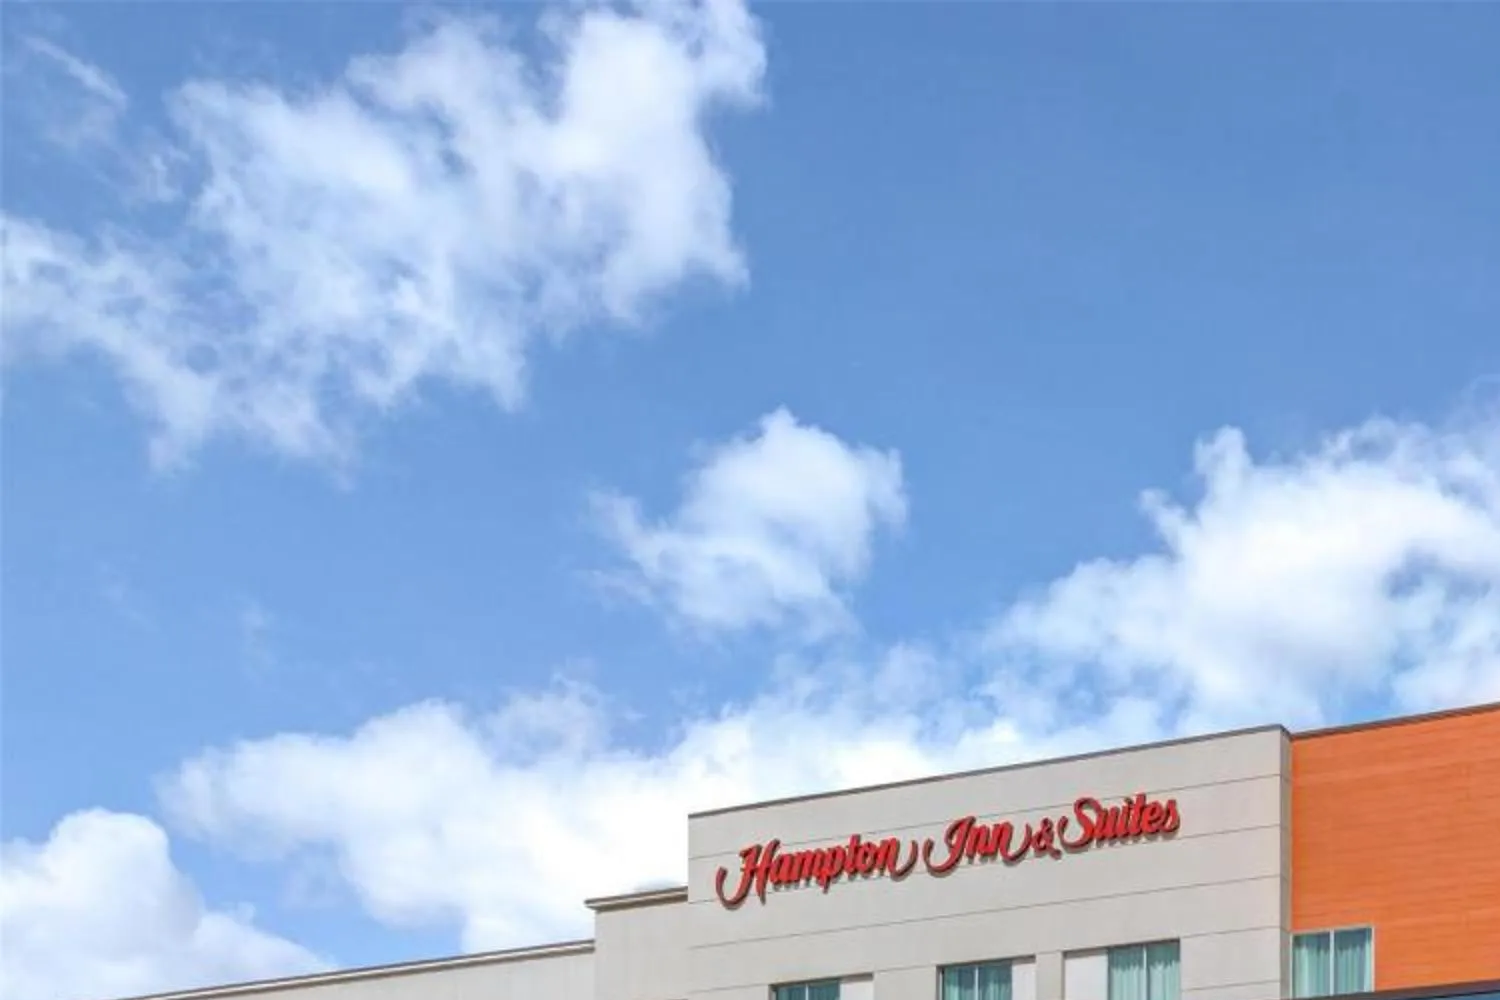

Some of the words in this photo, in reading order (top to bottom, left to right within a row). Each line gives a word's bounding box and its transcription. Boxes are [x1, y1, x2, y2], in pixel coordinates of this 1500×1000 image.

[715, 833, 917, 908] Hampton
[922, 815, 1032, 877] Inn
[1032, 817, 1062, 857] &
[1059, 792, 1180, 850] Suites
